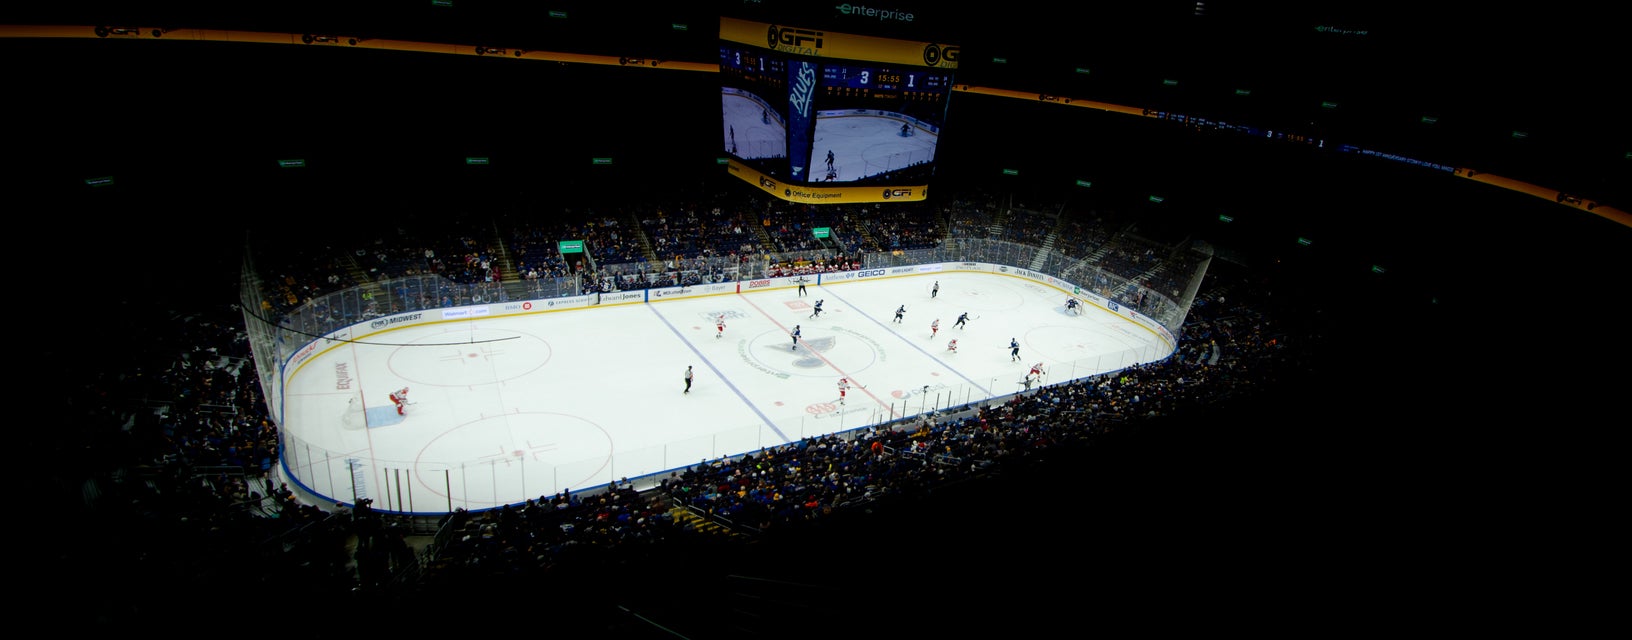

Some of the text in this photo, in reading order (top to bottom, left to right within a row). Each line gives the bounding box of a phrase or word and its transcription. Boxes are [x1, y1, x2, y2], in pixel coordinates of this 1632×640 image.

[835, 3, 914, 21] enterprise
[735, 52, 741, 66] 3
[759, 58, 765, 72] 1
[860, 70, 870, 85] 3
[878, 74, 900, 83] 15:55
[907, 74, 915, 88] 1
[789, 61, 816, 115] BLUES
[792, 190, 842, 200] Office Equipment
[857, 269, 886, 278] GEICO
[622, 292, 641, 301] Jones
[389, 313, 422, 325] MIDWEST
[336, 362, 351, 390] EQUIFAX
